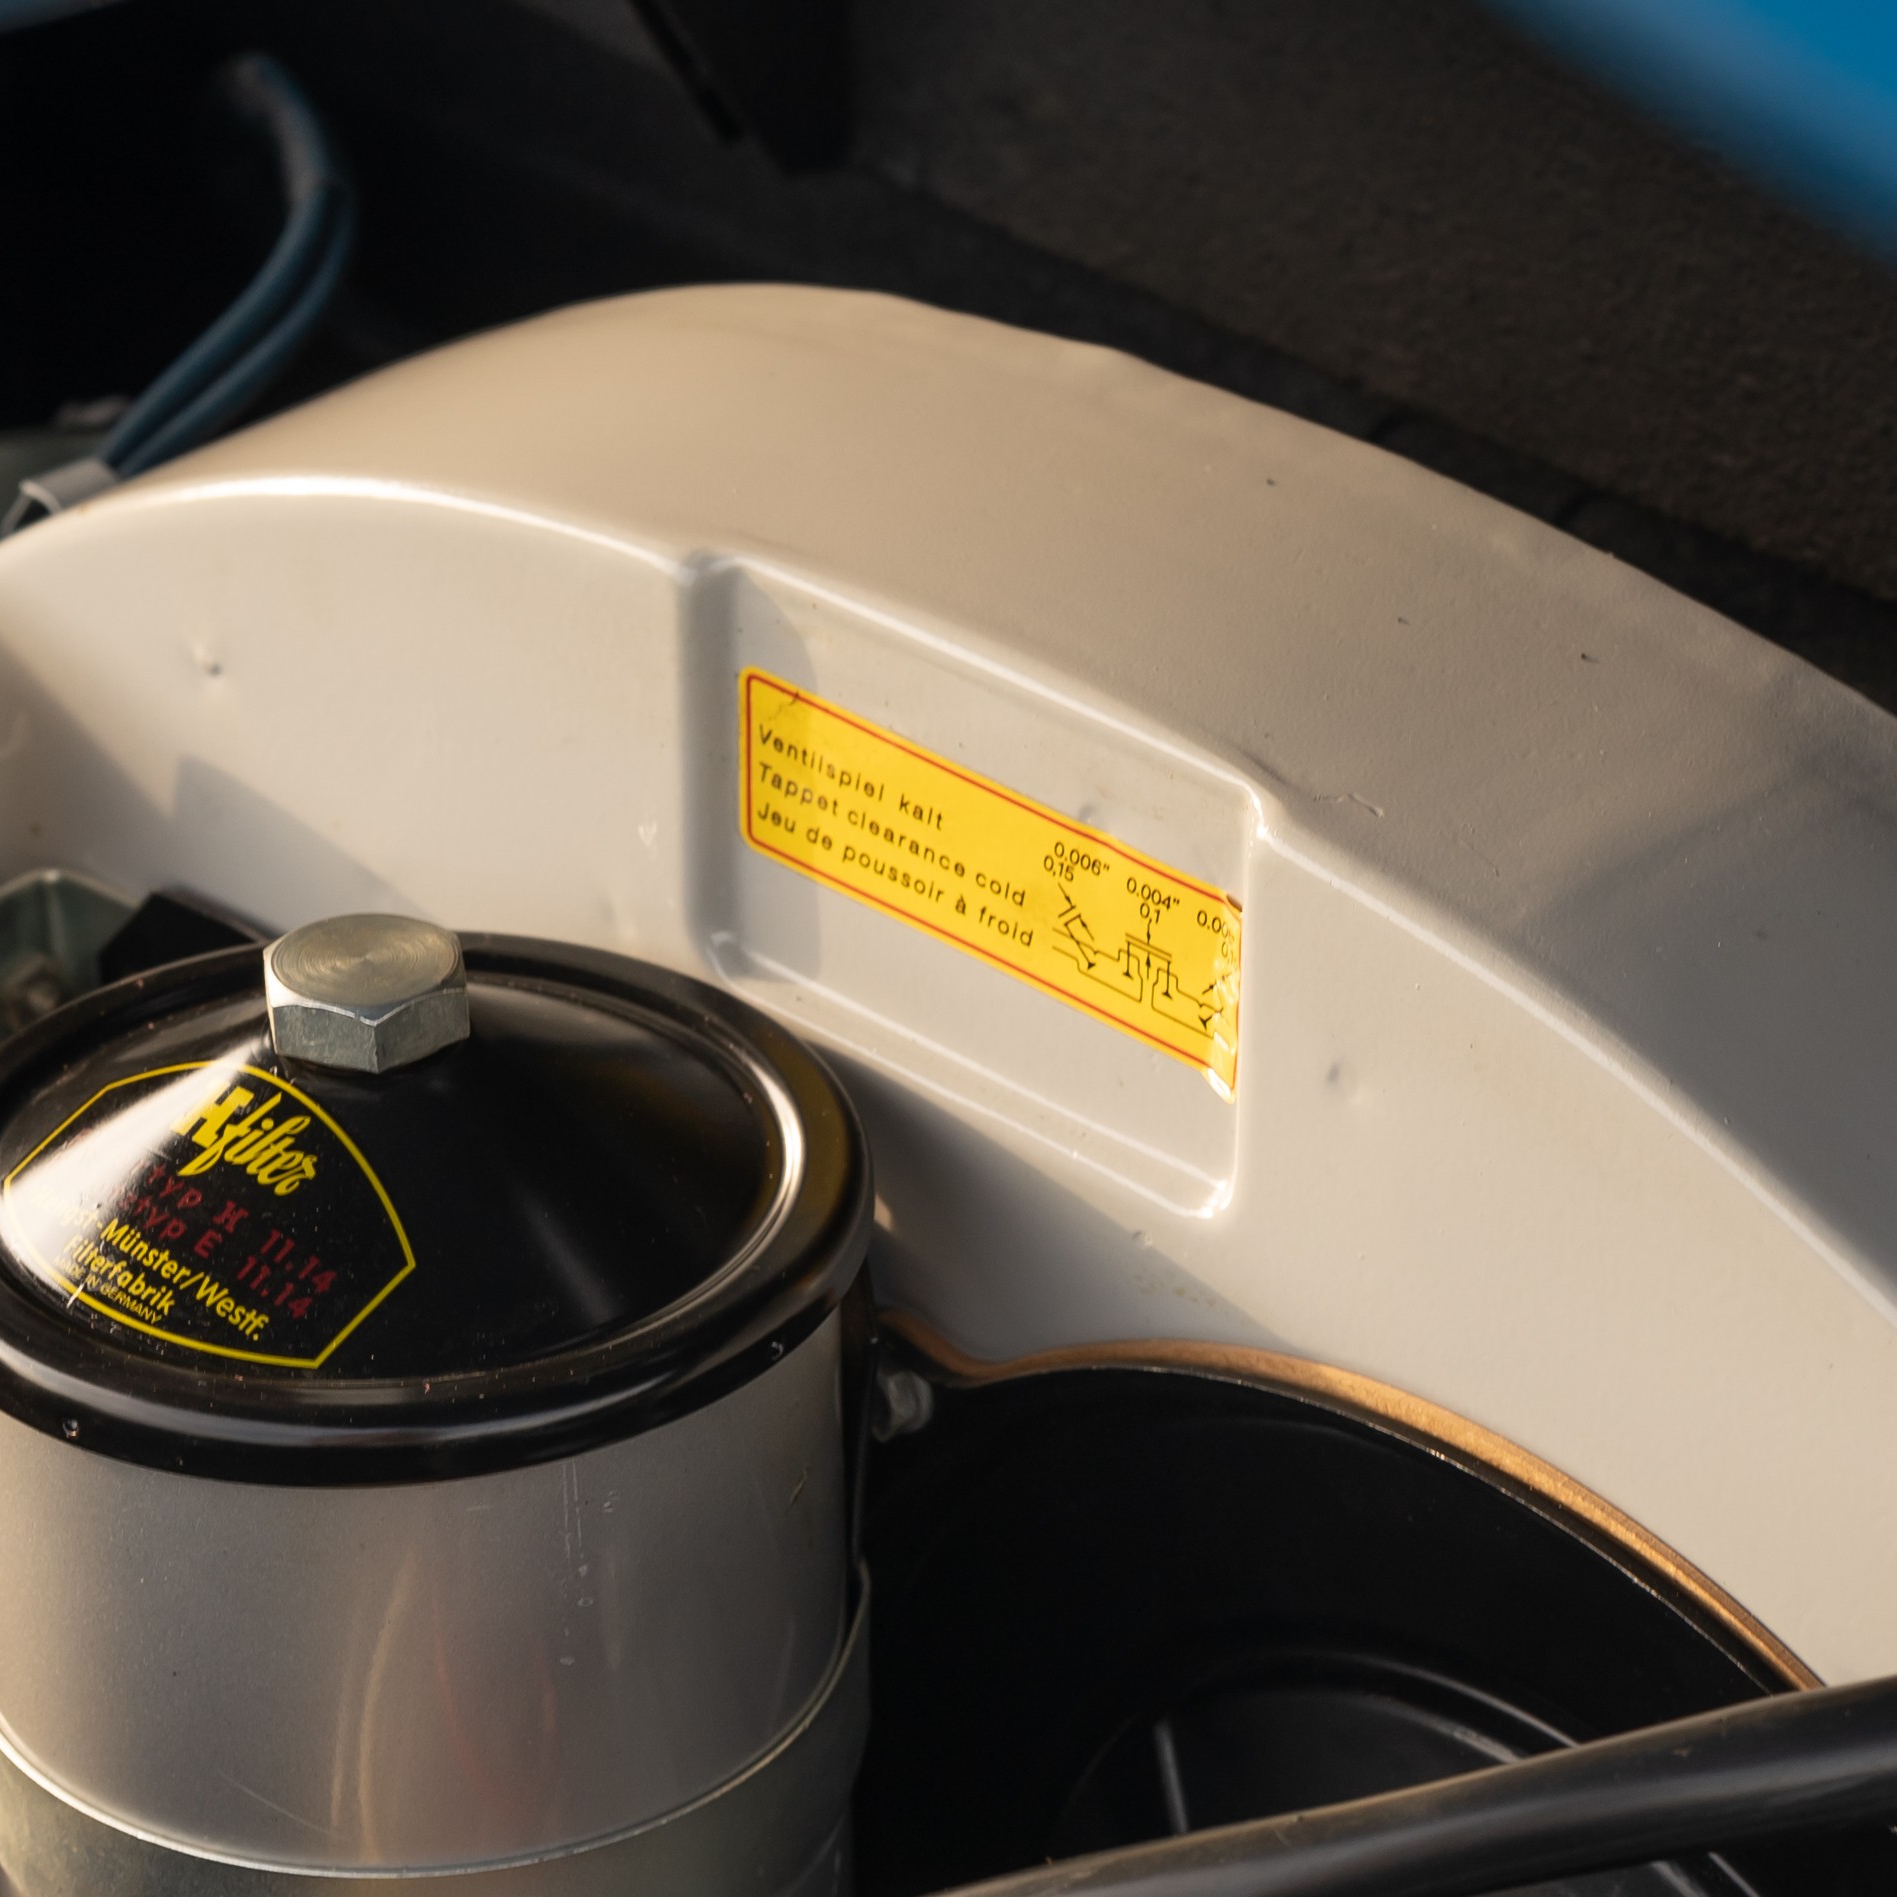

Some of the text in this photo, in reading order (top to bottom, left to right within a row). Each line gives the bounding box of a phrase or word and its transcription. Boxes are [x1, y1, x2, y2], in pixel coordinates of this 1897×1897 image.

[758, 724, 944, 830] Ventilspiel kalt
[757, 802, 1034, 947] Jeu de poussoir à froid
[758, 762, 1027, 907] Tappet clearance cold
[63, 1233, 176, 1317] Filterfabrik
[100, 1282, 163, 1325] GERMANY
[194, 1228, 223, 1260] E
[237, 1255, 313, 1319] 11.14
[260, 1228, 338, 1295] 11.14
